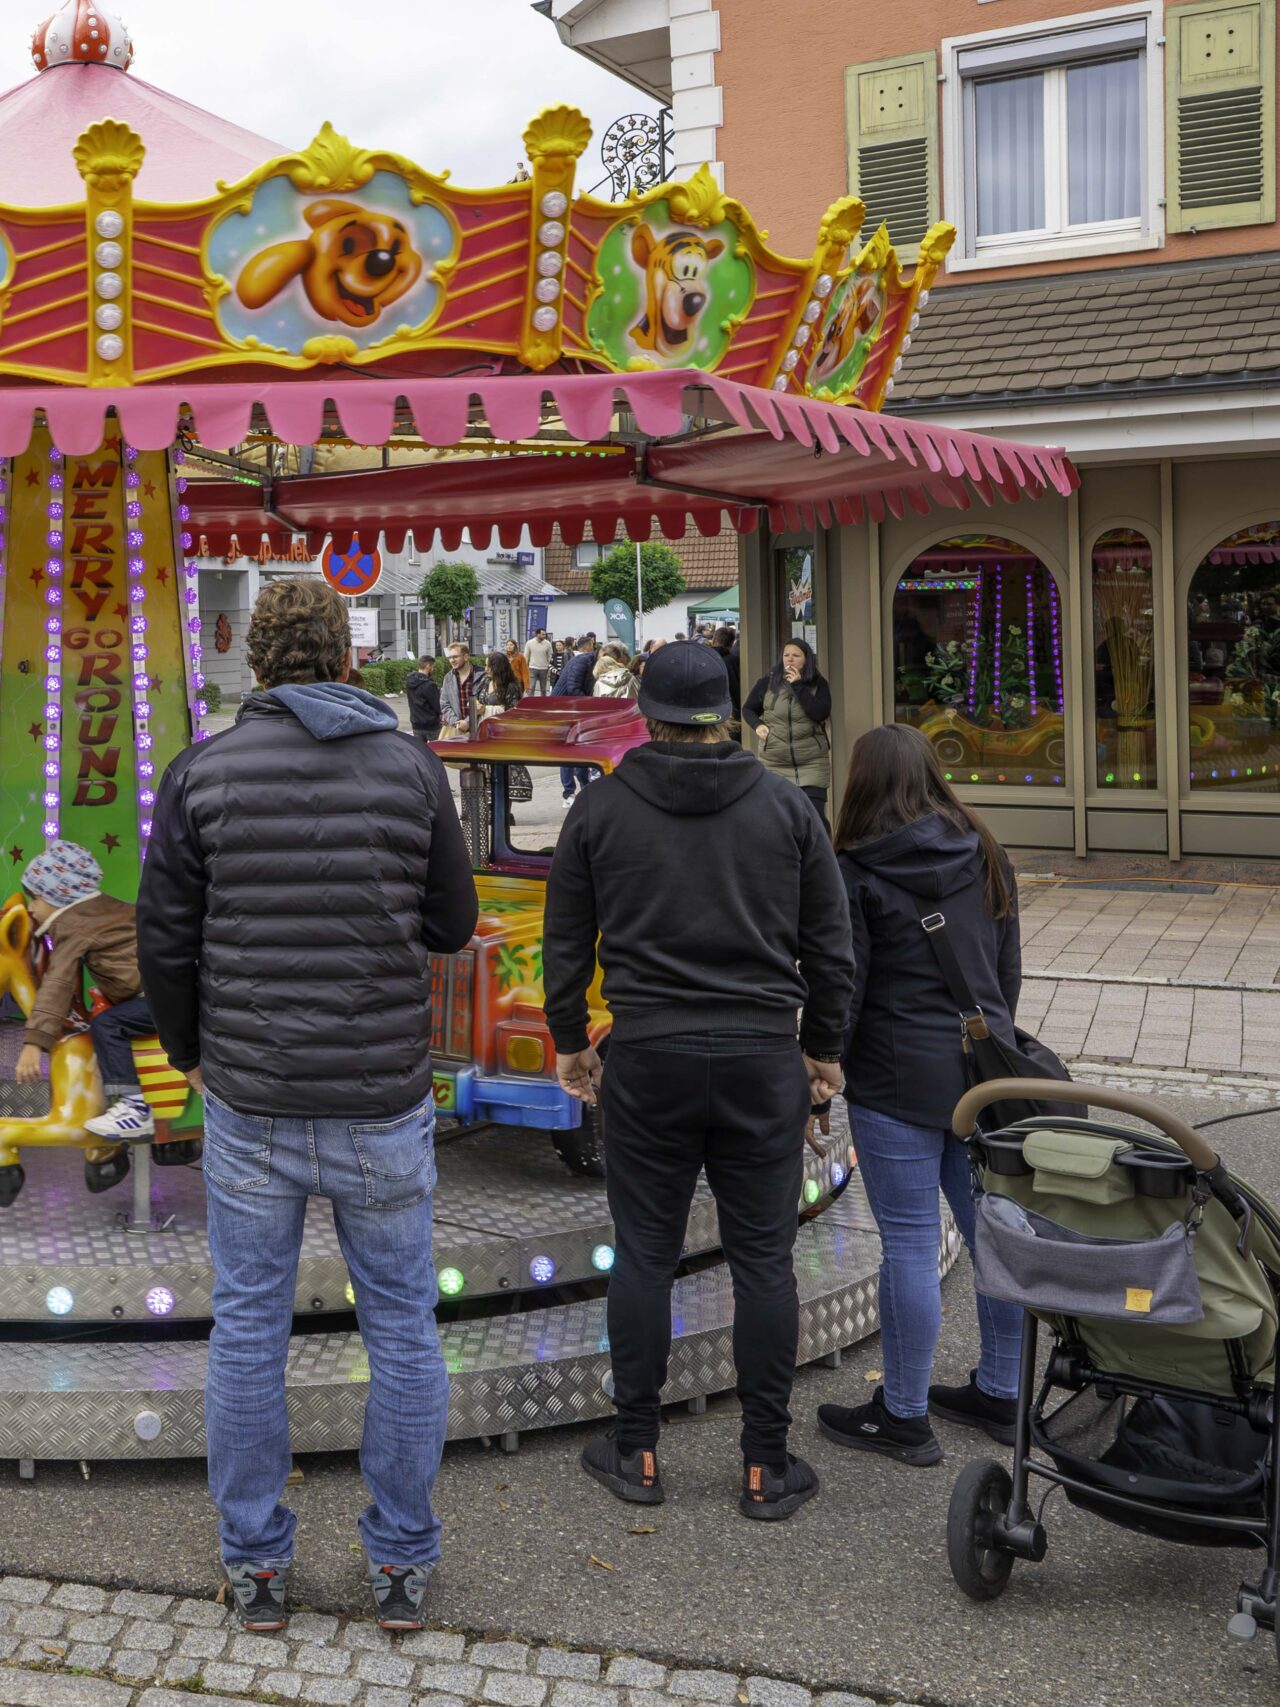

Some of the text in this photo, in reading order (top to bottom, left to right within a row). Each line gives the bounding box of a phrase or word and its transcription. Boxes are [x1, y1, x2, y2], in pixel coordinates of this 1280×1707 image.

[70, 460, 119, 622] MERRY
[62, 627, 123, 651] GO
[70, 653, 123, 807] ROUND
